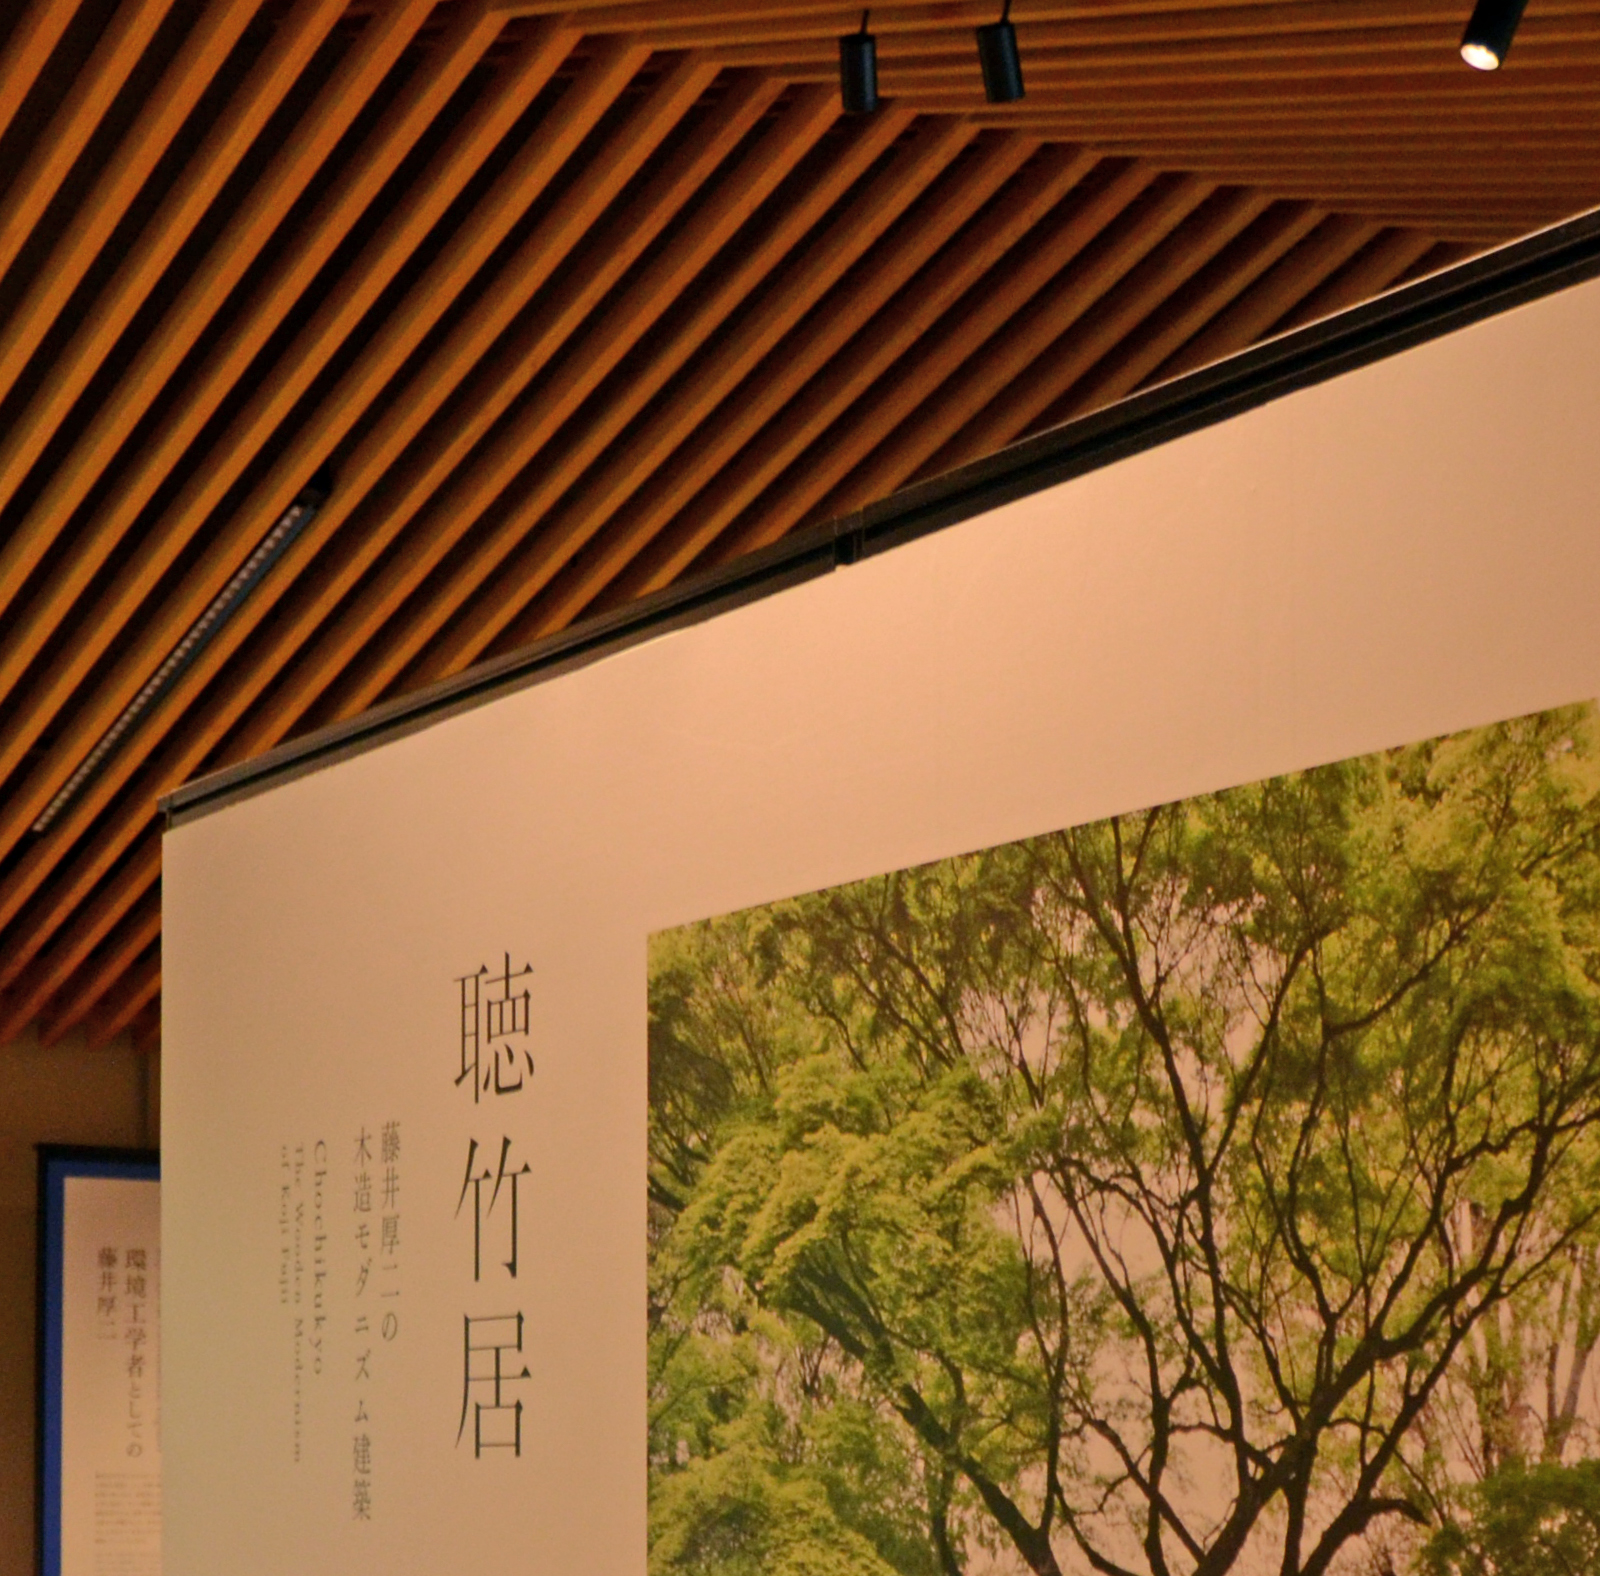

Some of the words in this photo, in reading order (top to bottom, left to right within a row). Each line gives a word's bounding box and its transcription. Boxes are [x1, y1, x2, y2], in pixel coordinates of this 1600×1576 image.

[294, 1203, 305, 1304] Wooden
[311, 1139, 328, 1376] Chochikukyo
[380, 1120, 401, 1342] 藤井厚二の
[453, 951, 535, 1460] 聴竹居
[293, 1318, 304, 1464] Modernism
[353, 1126, 372, 1521] 木造モダニズム建築
